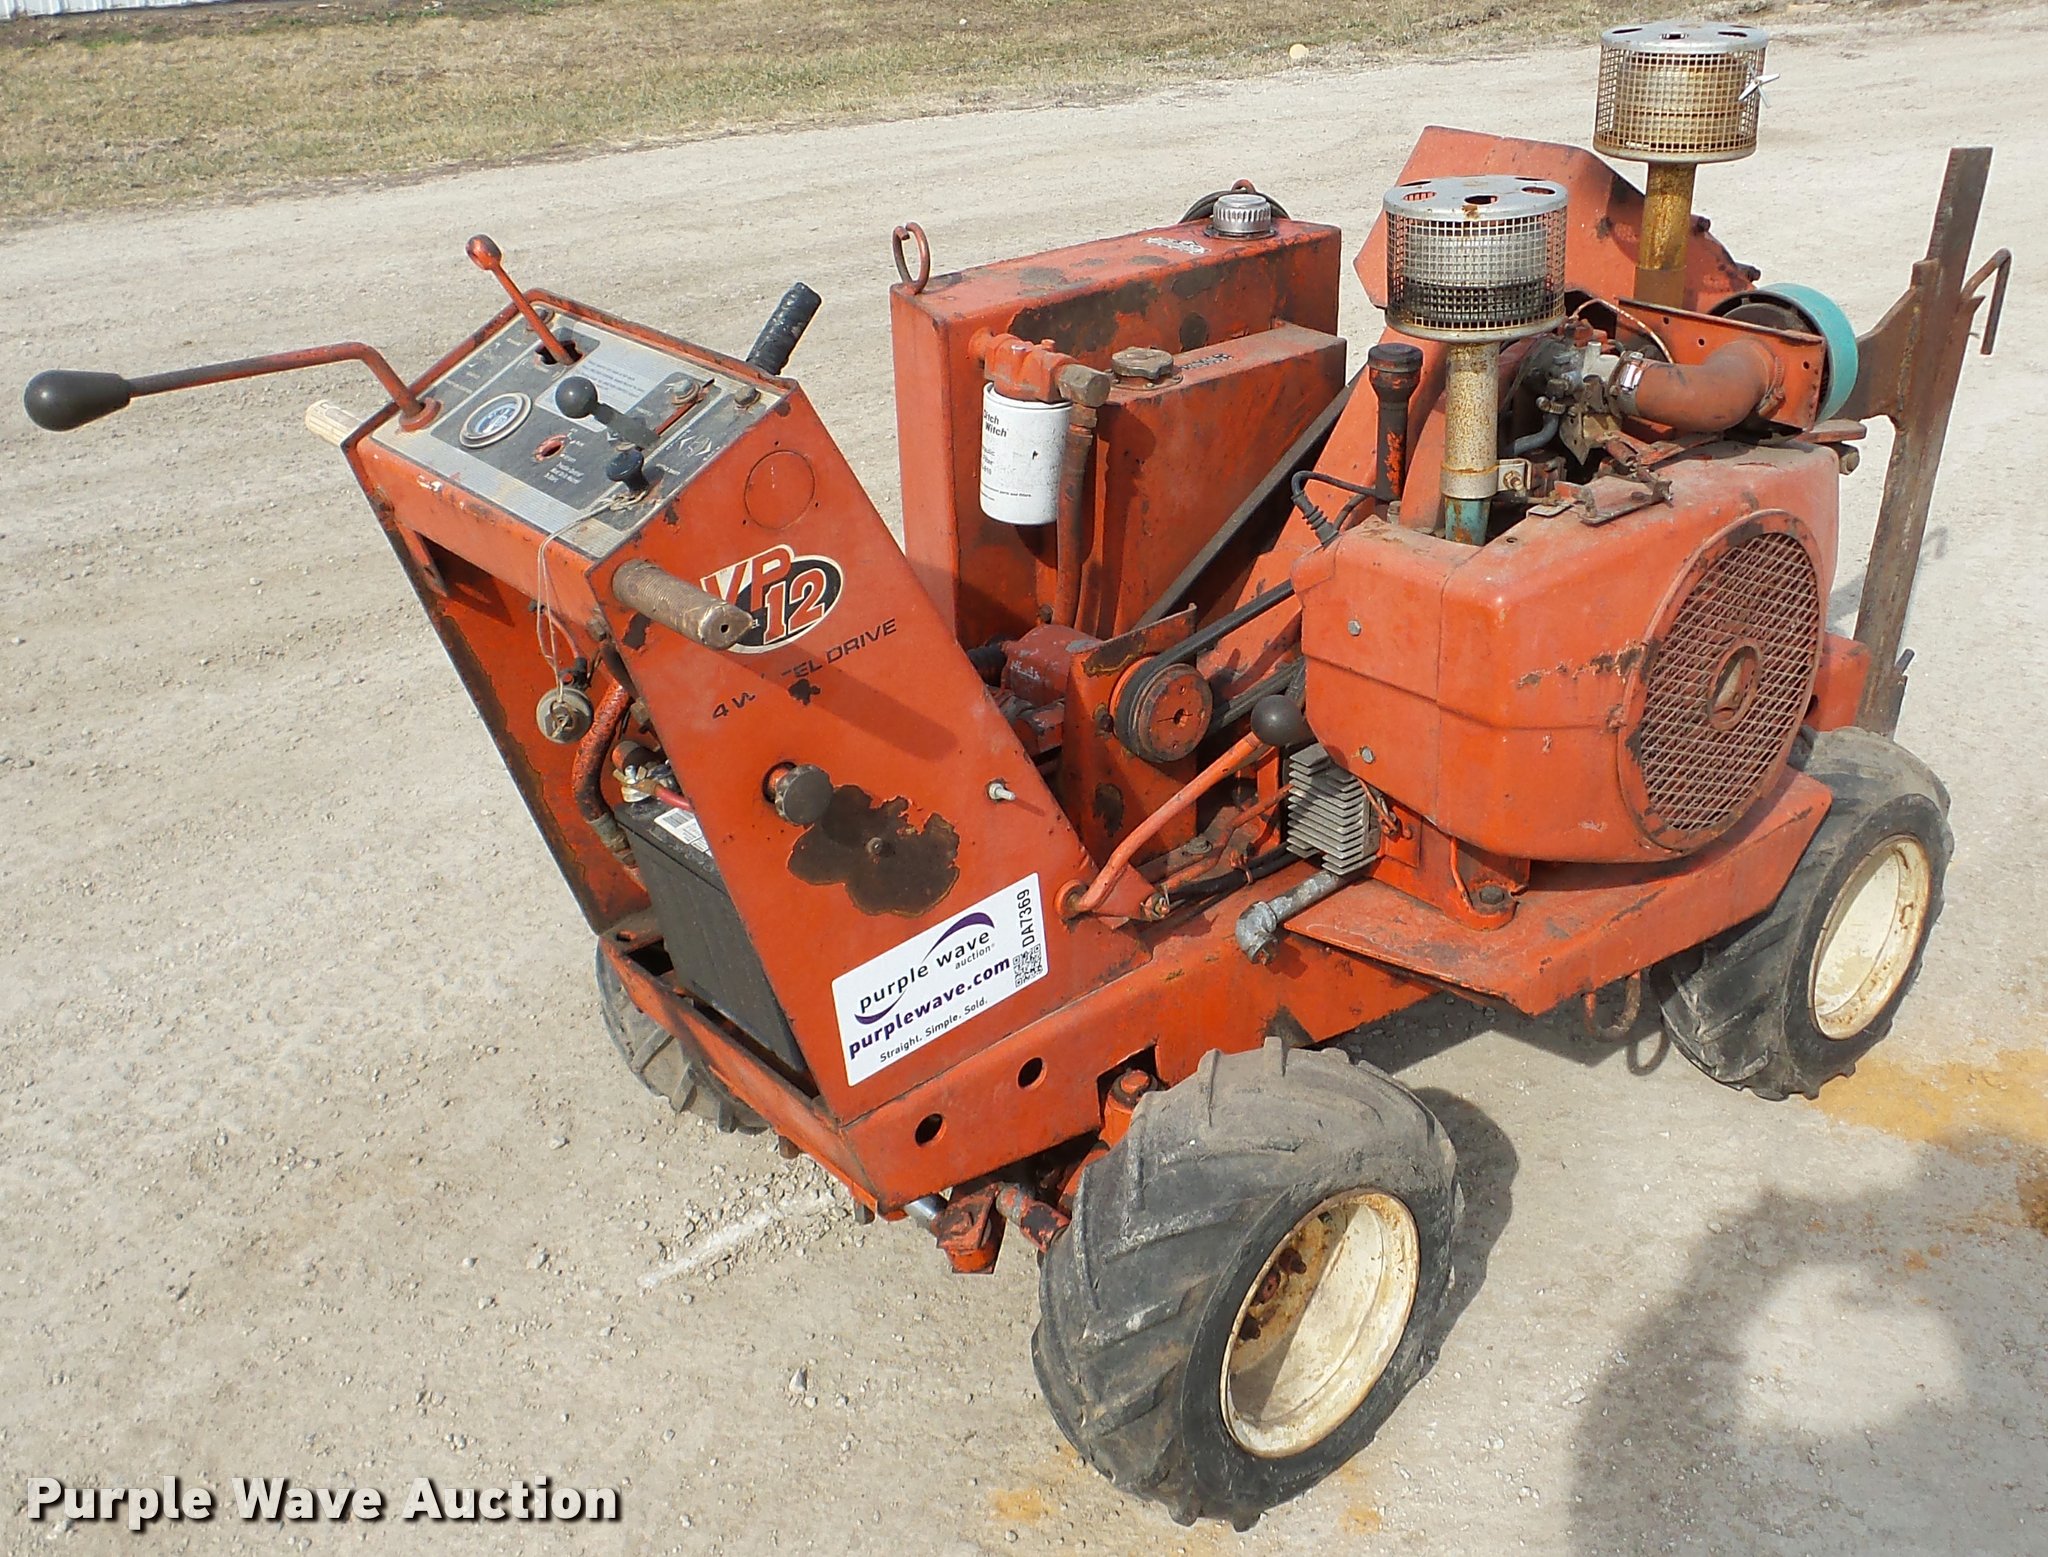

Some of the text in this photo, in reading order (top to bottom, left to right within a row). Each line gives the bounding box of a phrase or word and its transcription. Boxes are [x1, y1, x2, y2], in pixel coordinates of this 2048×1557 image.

[985, 421, 1007, 437] Witch
[763, 567, 827, 645] 12
[712, 703, 729, 719] 4
[826, 618, 897, 664] DRIVE
[1016, 888, 1035, 948] DA7369
[860, 931, 990, 1014] purple wave
[955, 945, 992, 970] auction
[849, 957, 1011, 1060] purplewave.com
[880, 997, 988, 1063] Straight. Simple. Sold.
